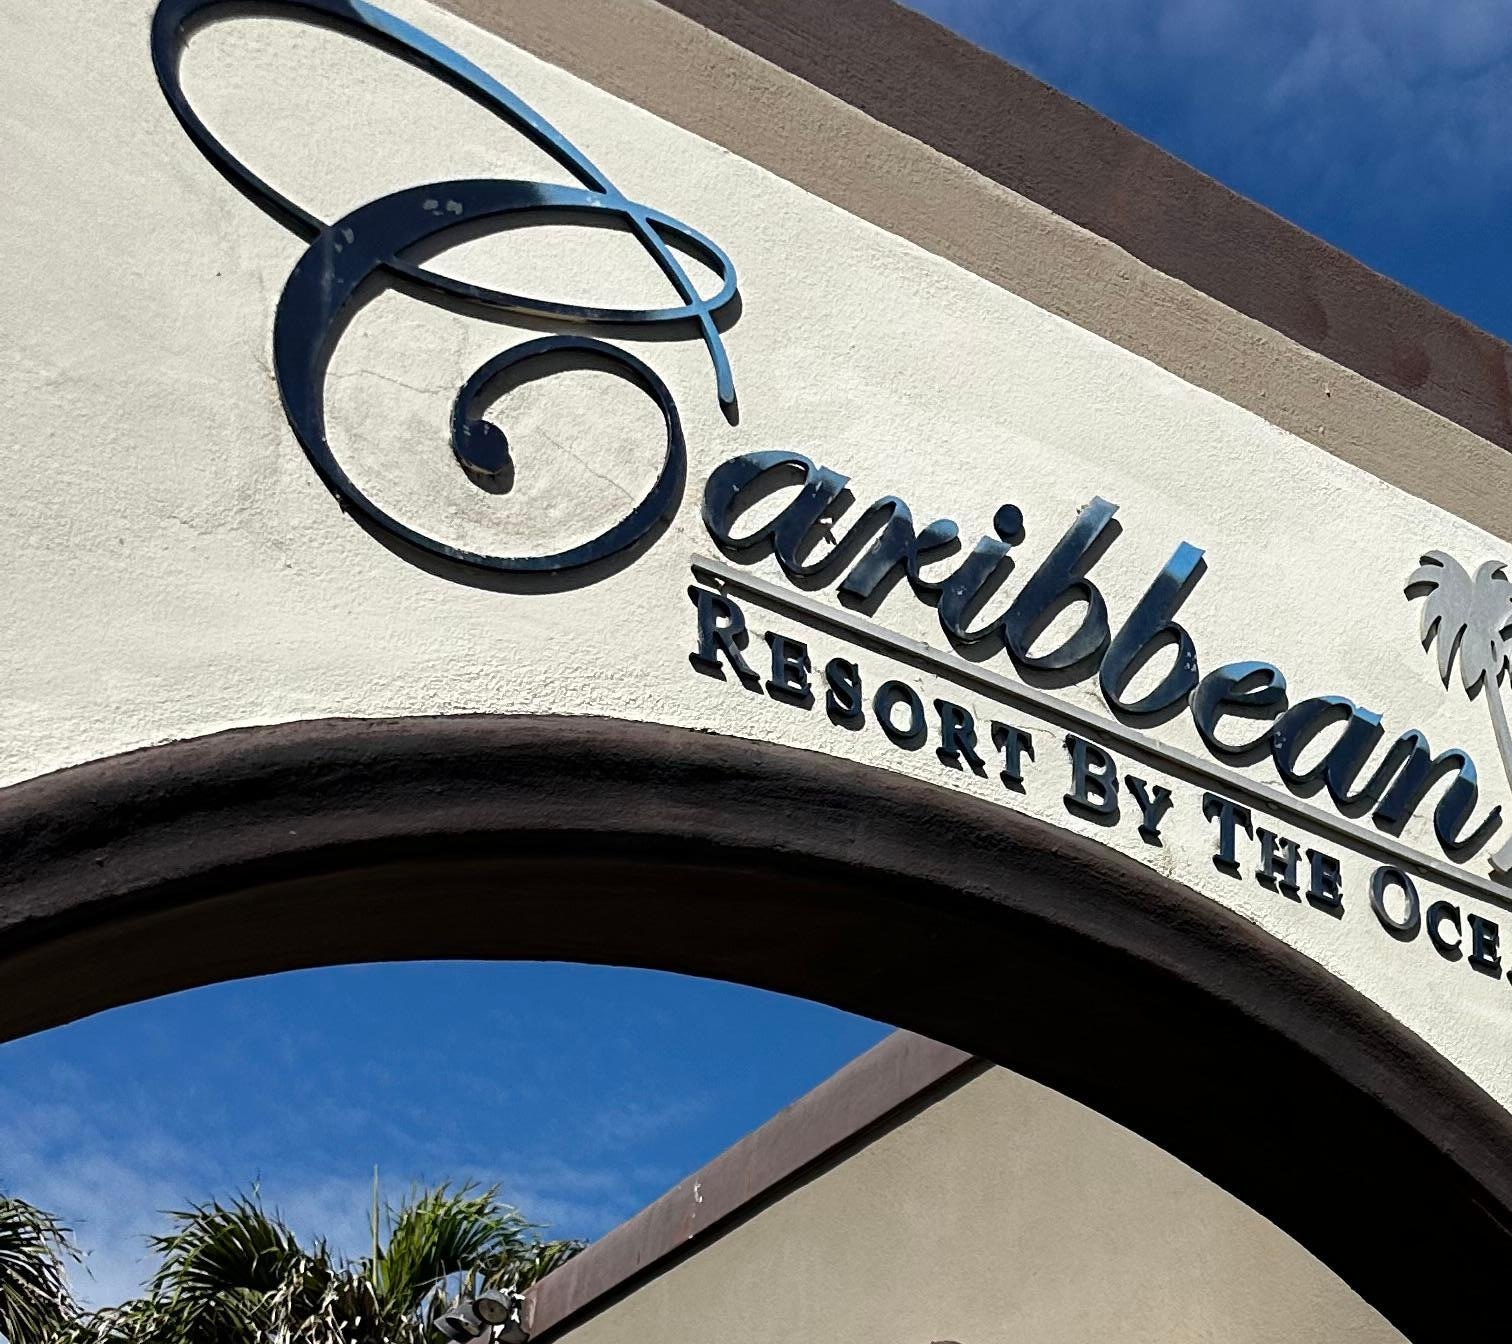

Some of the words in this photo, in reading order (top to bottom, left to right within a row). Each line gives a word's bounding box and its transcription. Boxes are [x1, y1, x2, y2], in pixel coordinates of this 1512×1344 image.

[150, 0, 1502, 852] Caribbean
[688, 585, 1034, 790] RESORT
[1064, 734, 1173, 842] BY
[1203, 792, 1344, 916] THE
